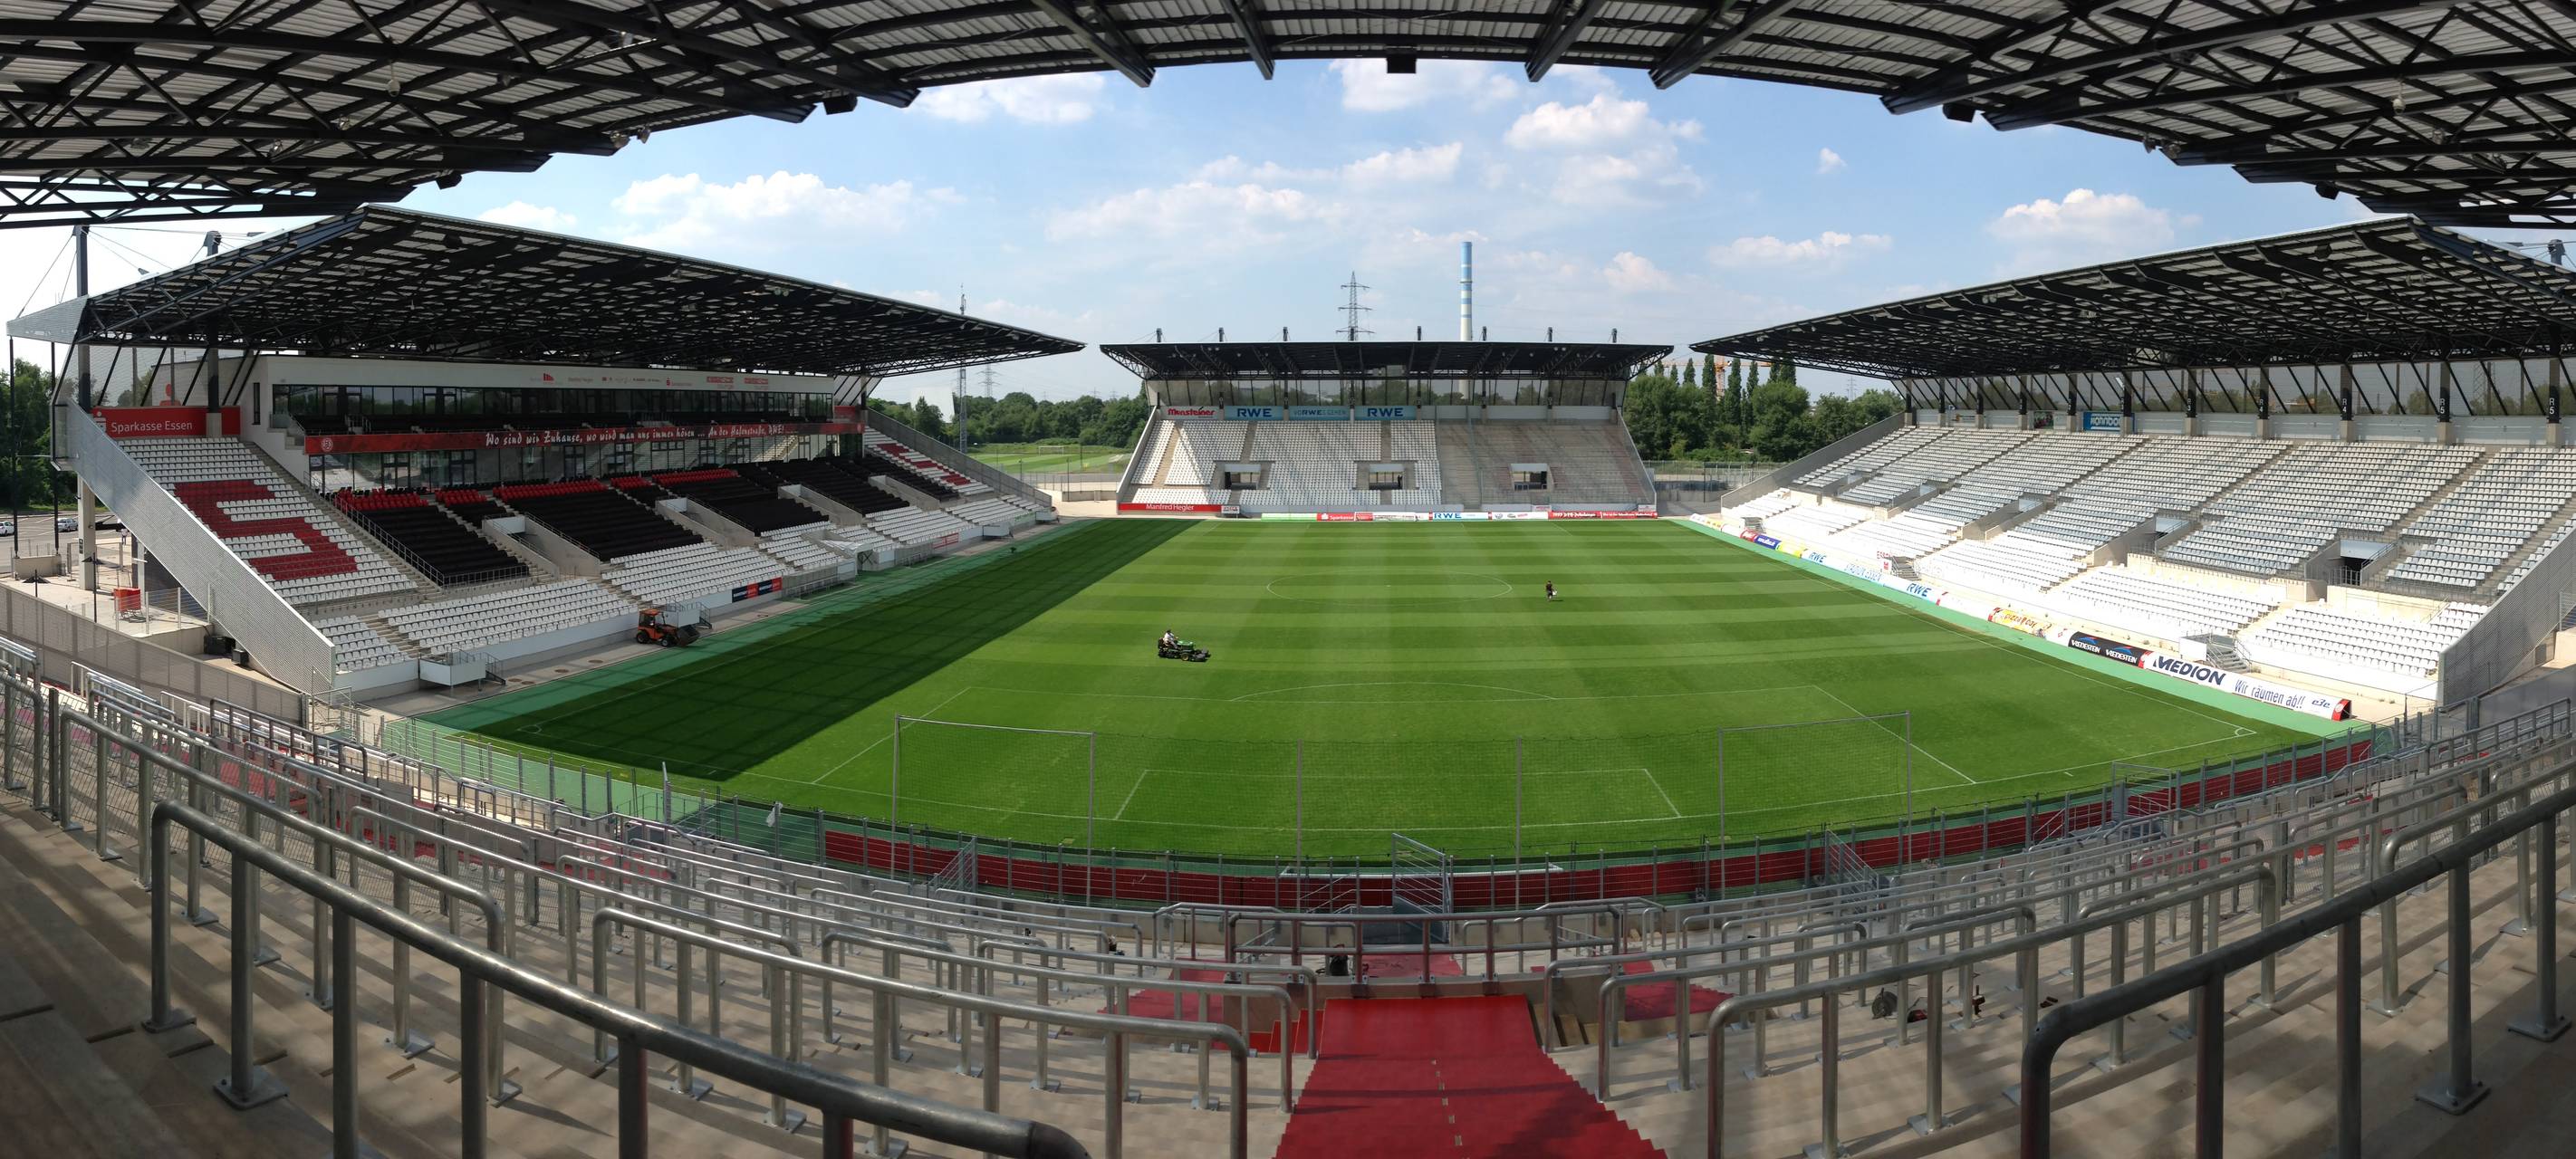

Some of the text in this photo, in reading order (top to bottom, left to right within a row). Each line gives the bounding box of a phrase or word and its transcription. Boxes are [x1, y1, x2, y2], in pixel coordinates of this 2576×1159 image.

[1236, 408, 1272, 417] RWE
[1367, 408, 1404, 417] RWE
[111, 420, 193, 434] Sparkasse Essen
[485, 433, 500, 446] Wo
[503, 434, 523, 445] sind
[600, 430, 617, 441] wird
[1173, 503, 1195, 512] Hegler
[1809, 551, 1828, 563] RWE
[1906, 582, 1932, 598] RWE
[2152, 656, 2226, 685] MEDION
[2235, 679, 2306, 710] Wir räumen ab!!
